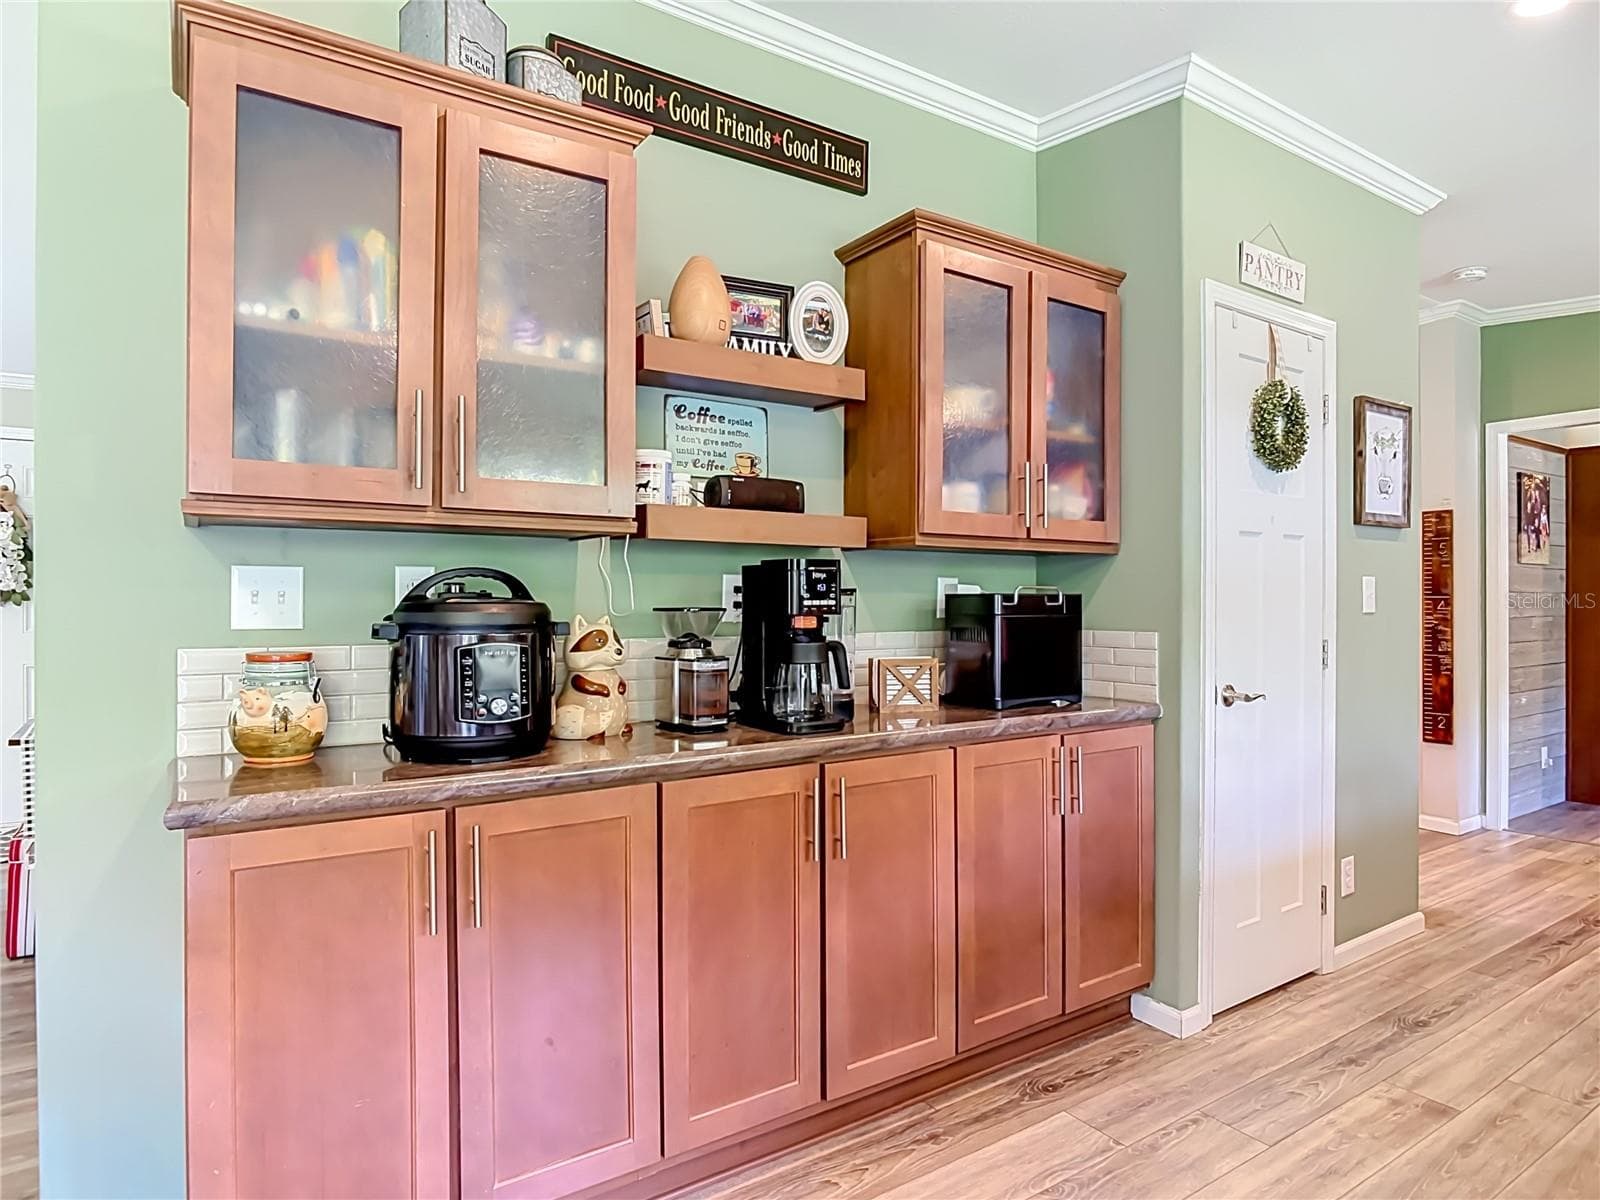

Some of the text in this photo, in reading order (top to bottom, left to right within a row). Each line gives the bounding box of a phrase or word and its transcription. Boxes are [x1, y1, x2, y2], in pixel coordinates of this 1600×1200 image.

[464, 53, 491, 76] SUGAR
[614, 71, 654, 113] Food
[668, 91, 710, 131] Good
[715, 106, 771, 150] Friends
[782, 128, 818, 165] Good
[822, 141, 862, 178] Times
[1244, 252, 1304, 291] PANTRY
[724, 336, 793, 358] AMILY
[673, 403, 753, 428] Coffee spelled
[675, 423, 718, 435] backwards
[719, 428, 726, 436] is
[681, 435, 702, 445] don't
[703, 438, 719, 447] give
[676, 447, 728, 459] until I've had
[676, 460, 689, 469] my
[1437, 716, 1447, 729] 2
